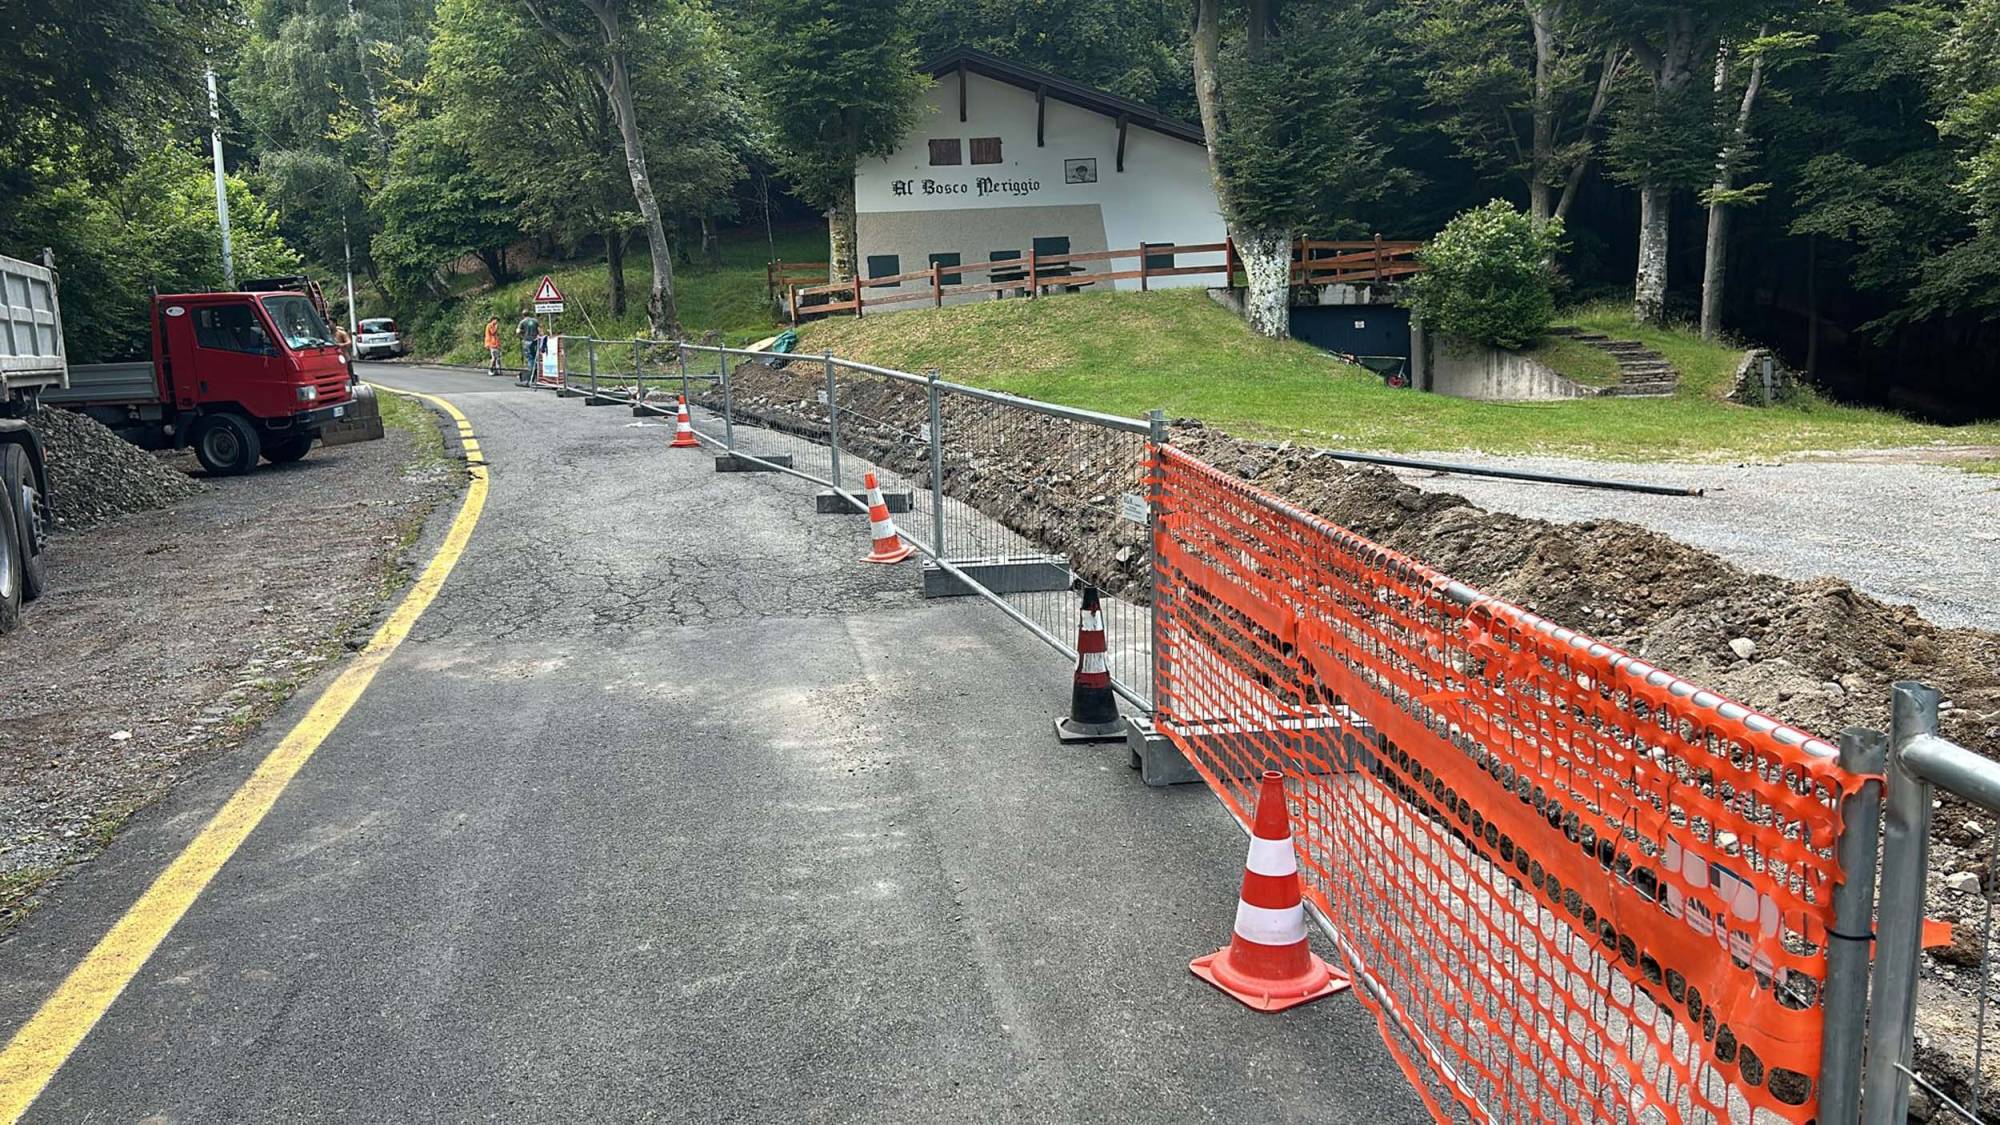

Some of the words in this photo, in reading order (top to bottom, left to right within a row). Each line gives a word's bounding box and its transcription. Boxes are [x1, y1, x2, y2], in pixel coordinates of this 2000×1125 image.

[892, 179, 914, 197] Al
[921, 178, 968, 195] Bosco
[976, 176, 1040, 197] Meriggio
